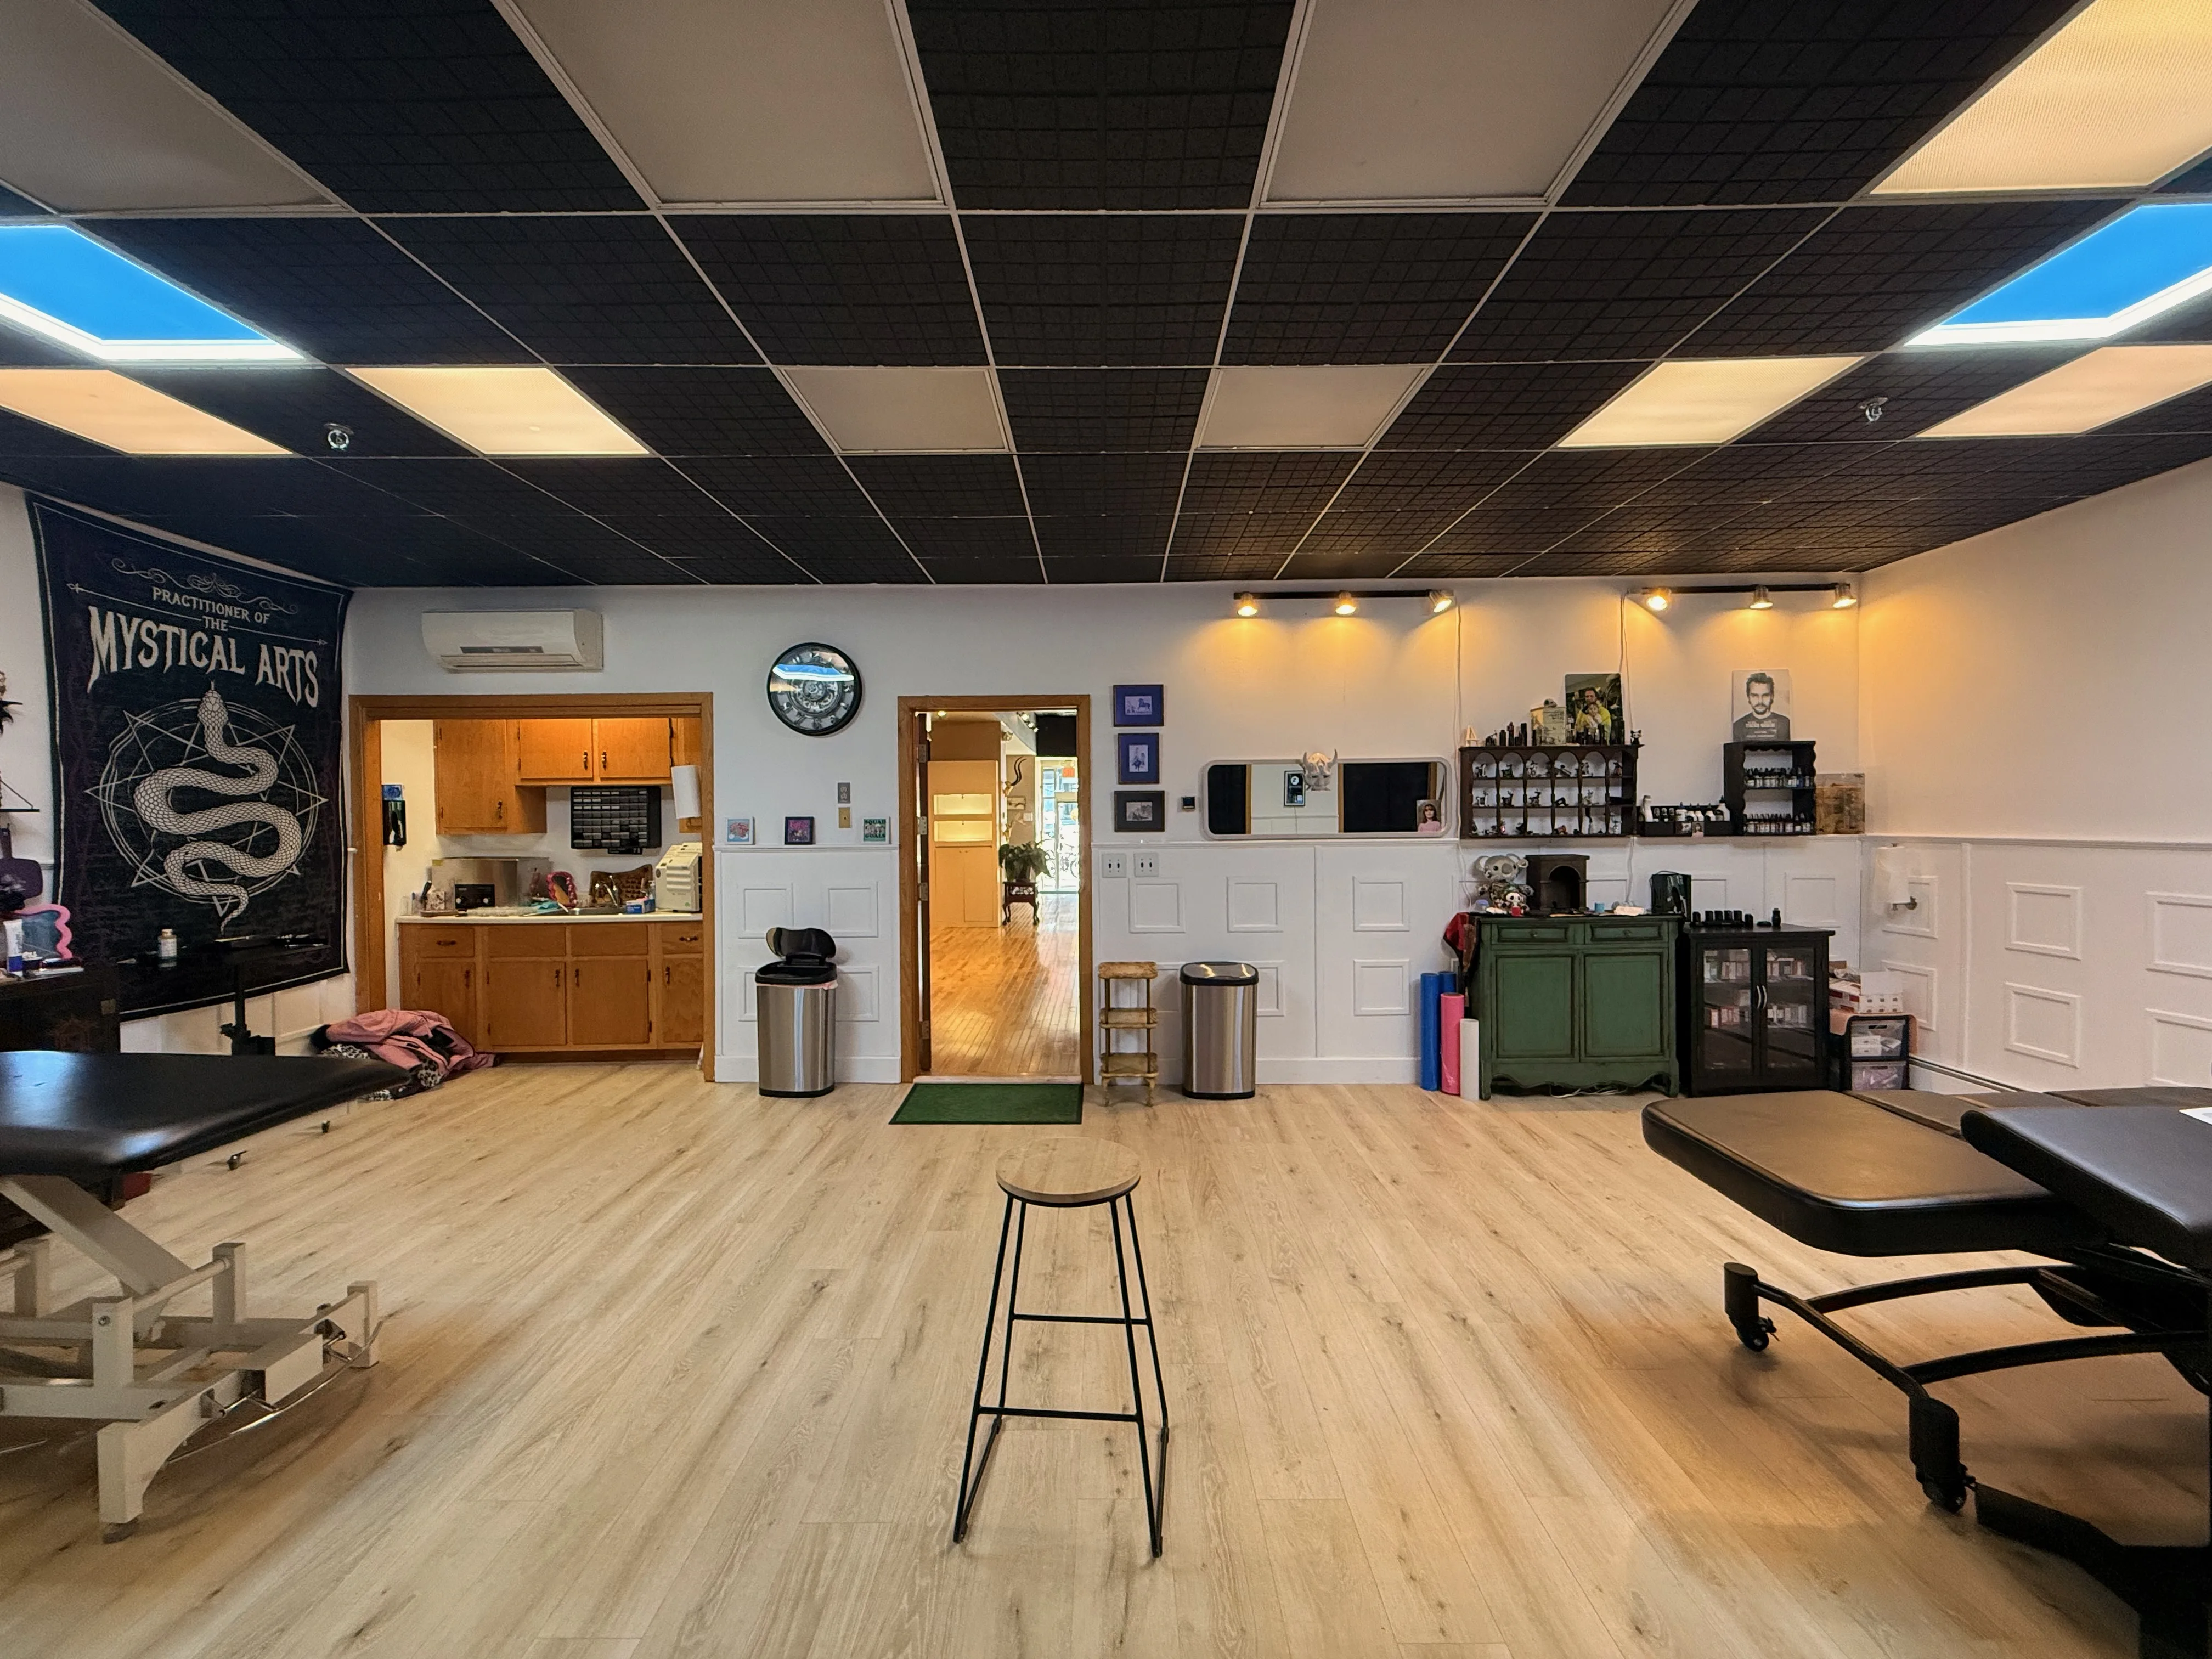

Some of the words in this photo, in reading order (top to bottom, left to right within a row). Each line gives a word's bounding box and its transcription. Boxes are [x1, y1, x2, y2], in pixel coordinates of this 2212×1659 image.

[152, 586, 250, 622] PRACTITIONER
[254, 611, 271, 625] OF
[202, 615, 229, 633] THE
[87, 605, 245, 693] MYSTICAL
[255, 644, 319, 708] ARTS
